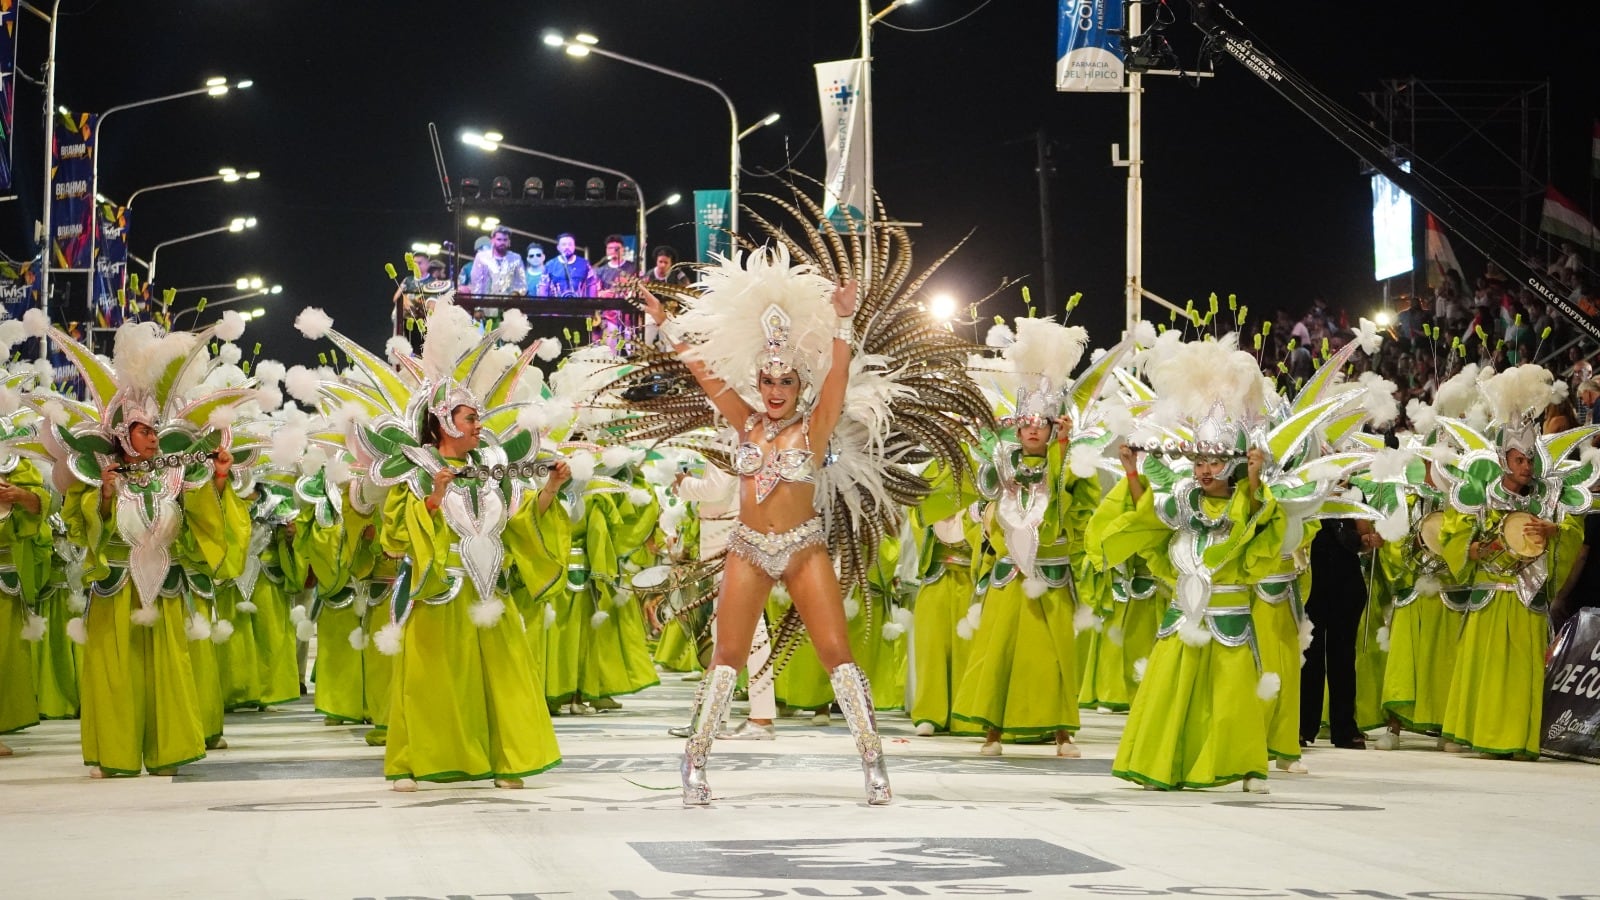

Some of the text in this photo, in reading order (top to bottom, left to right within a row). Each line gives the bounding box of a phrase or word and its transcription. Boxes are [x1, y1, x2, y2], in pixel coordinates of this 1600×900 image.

[1079, 0, 1093, 31] CO
[1226, 42, 1247, 61] MULTI
[1064, 68, 1118, 79] DEL HÍPICO
[60, 143, 87, 156] BRAHMA
[55, 180, 87, 196] BRAHMA
[1551, 663, 1600, 700] DE CO
[608, 884, 1600, 900] LOUIS SCHO
